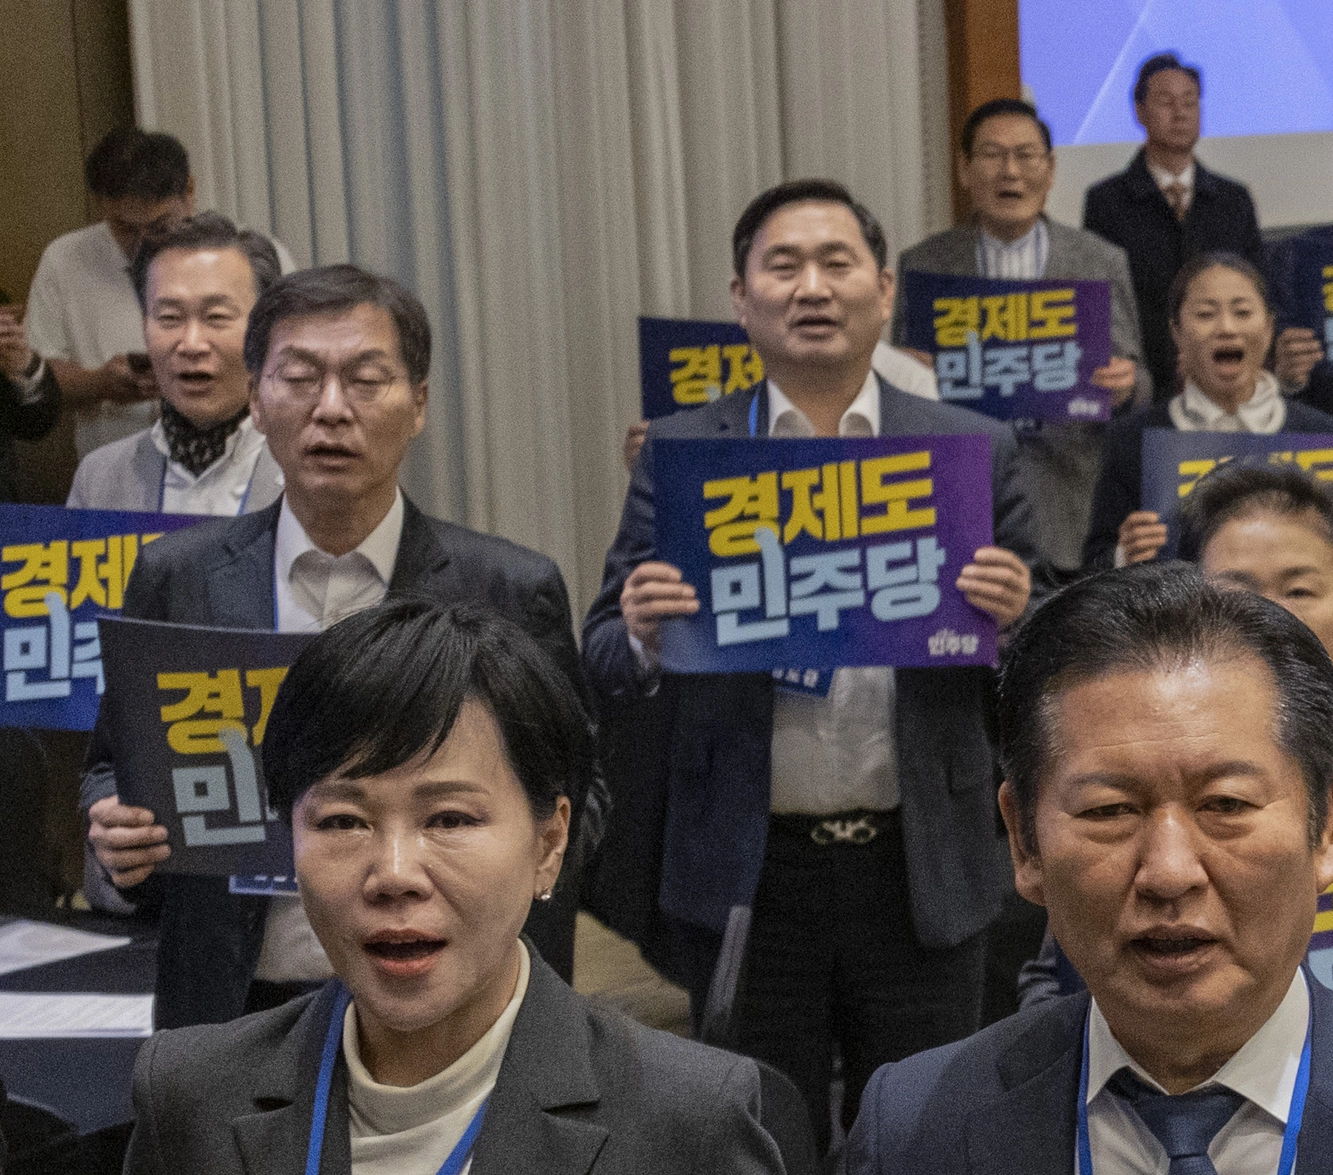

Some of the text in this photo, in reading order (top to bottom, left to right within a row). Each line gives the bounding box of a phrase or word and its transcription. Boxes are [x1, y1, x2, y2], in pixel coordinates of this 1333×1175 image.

[933, 289, 1077, 348] 경제도
[936, 331, 1082, 400] 민주당
[704, 451, 937, 557] 경제도
[711, 526, 946, 646] 민주당
